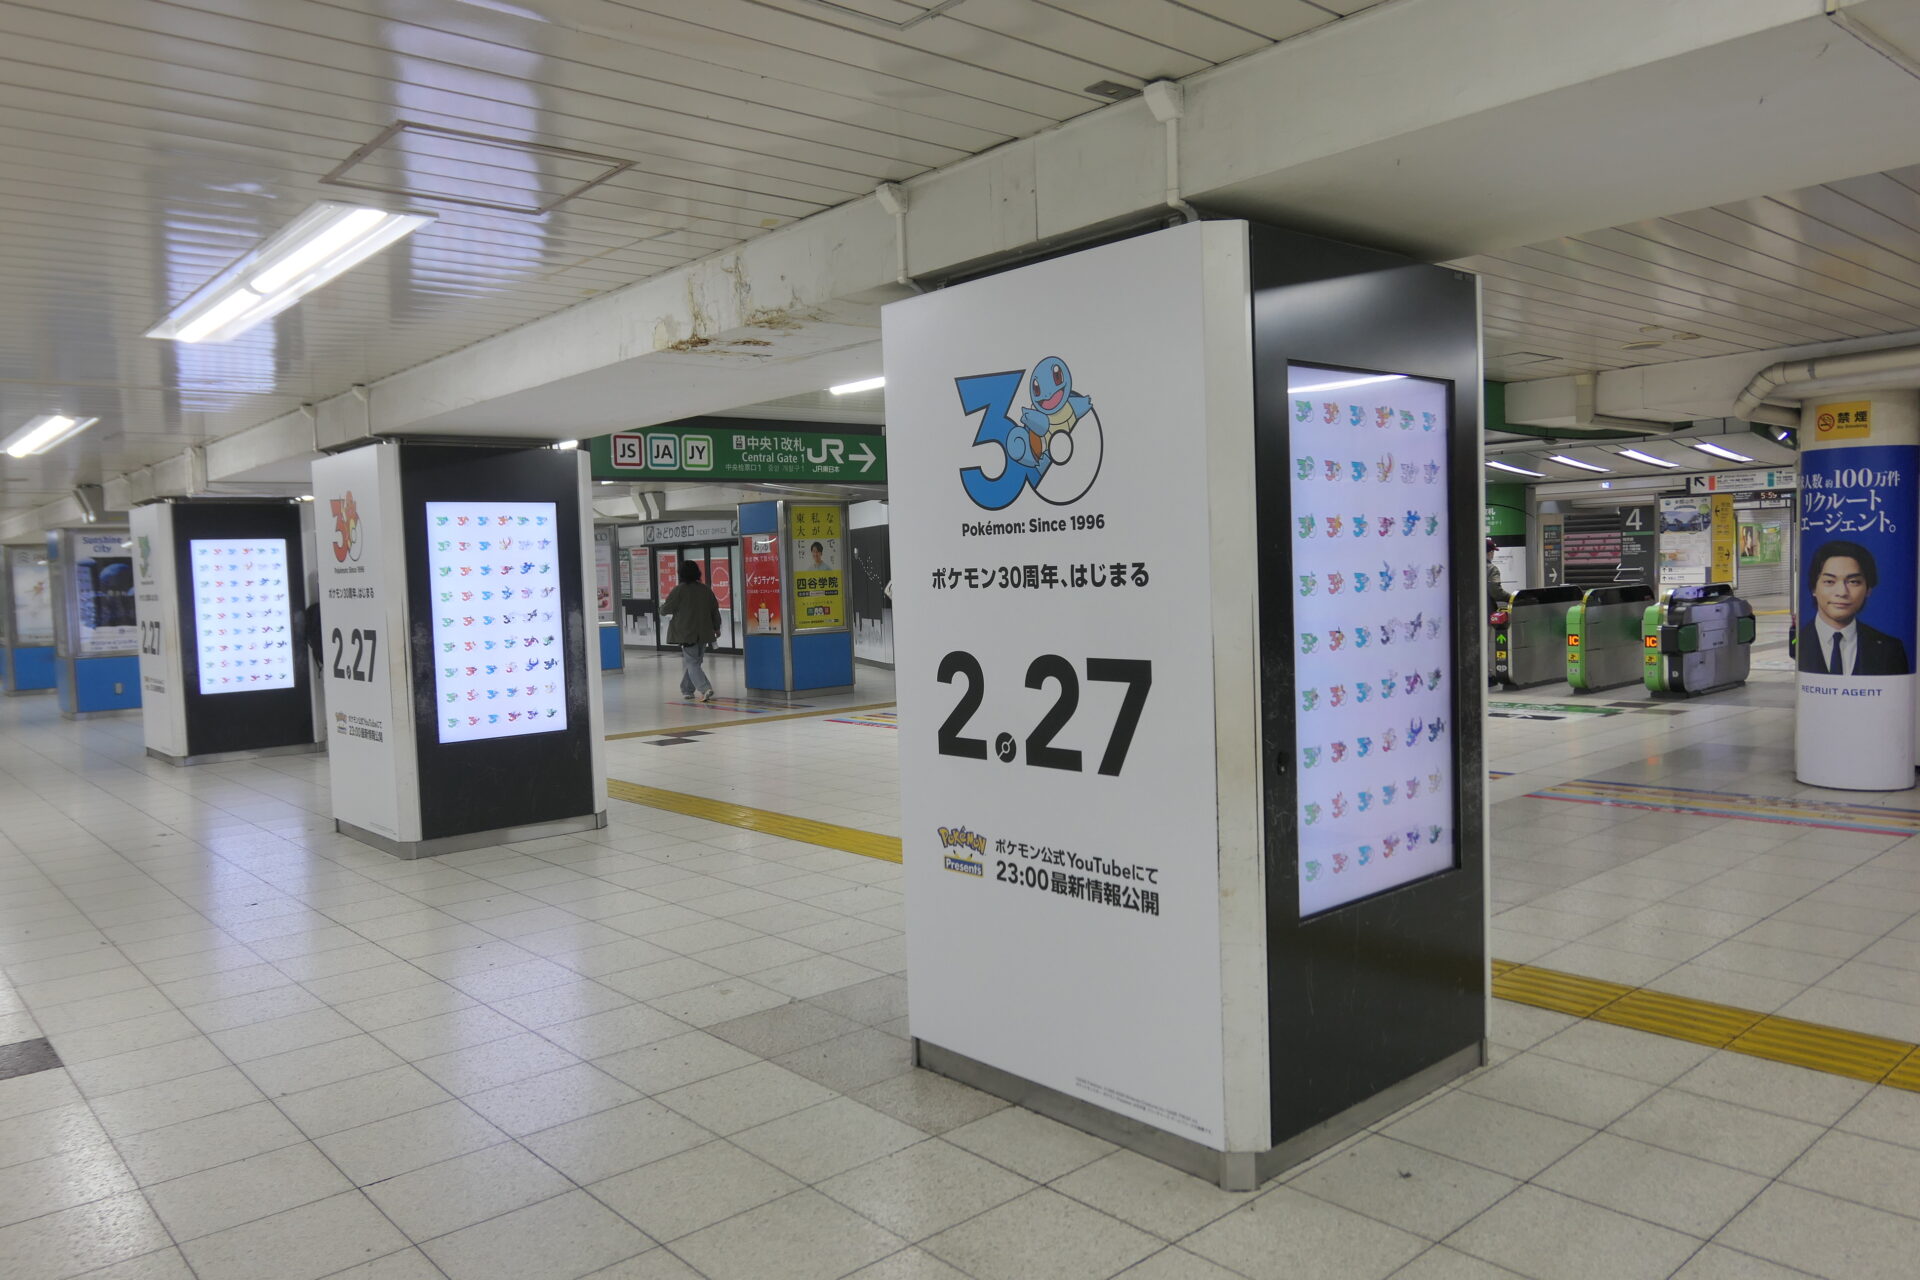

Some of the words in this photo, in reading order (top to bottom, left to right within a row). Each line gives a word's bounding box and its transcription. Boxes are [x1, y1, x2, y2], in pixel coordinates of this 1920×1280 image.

[1837, 410, 1868, 423] 禁煙
[620, 443, 636, 458] JS
[654, 445, 673, 459] JA
[689, 445, 706, 460] JY
[747, 437, 805, 452] 中央1改札
[807, 438, 845, 464] JR
[742, 452, 774, 463] Central
[777, 453, 797, 463] Gate
[801, 454, 805, 463] 1
[812, 466, 840, 474] JR東日本
[1805, 489, 1882, 513] リクルート
[962, 520, 1026, 536] Pokémon:
[1029, 517, 1067, 532] Since
[1070, 514, 1105, 530] 1996
[1626, 508, 1643, 530] 4
[1801, 510, 1896, 533] エージェント。
[82, 536, 122, 545] Sunshine
[655, 526, 694, 539] みどりの窓口
[797, 577, 838, 589] 四谷学院
[932, 562, 1149, 589] ポケモン30周年、はじまる
[1569, 635, 1579, 645] IC
[1646, 636, 1657, 647] IC
[332, 627, 377, 683] 2.27
[1802, 685, 1838, 696] RECRUIT
[1842, 688, 1883, 696] AGENT
[937, 650, 1152, 777] 2.27
[946, 858, 982, 875] Presents
